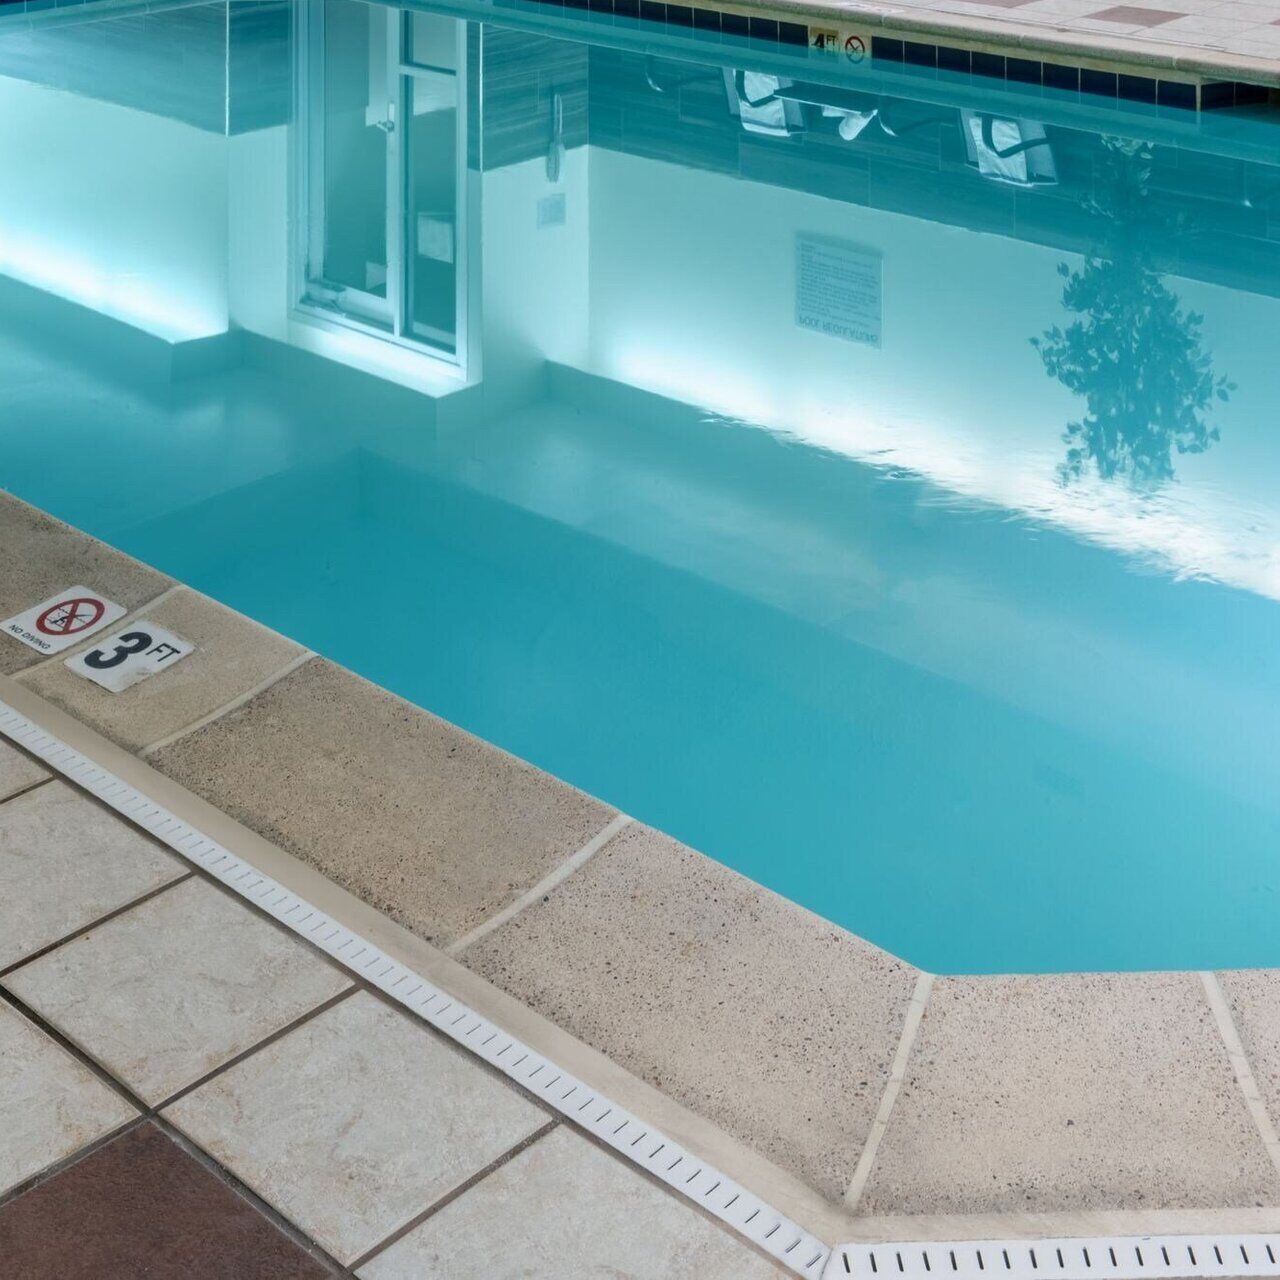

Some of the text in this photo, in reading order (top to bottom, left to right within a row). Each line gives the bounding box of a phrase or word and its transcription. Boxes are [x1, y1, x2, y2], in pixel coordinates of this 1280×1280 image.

[9, 623, 52, 650] NO DIVING
[83, 631, 181, 670] 3 FT
